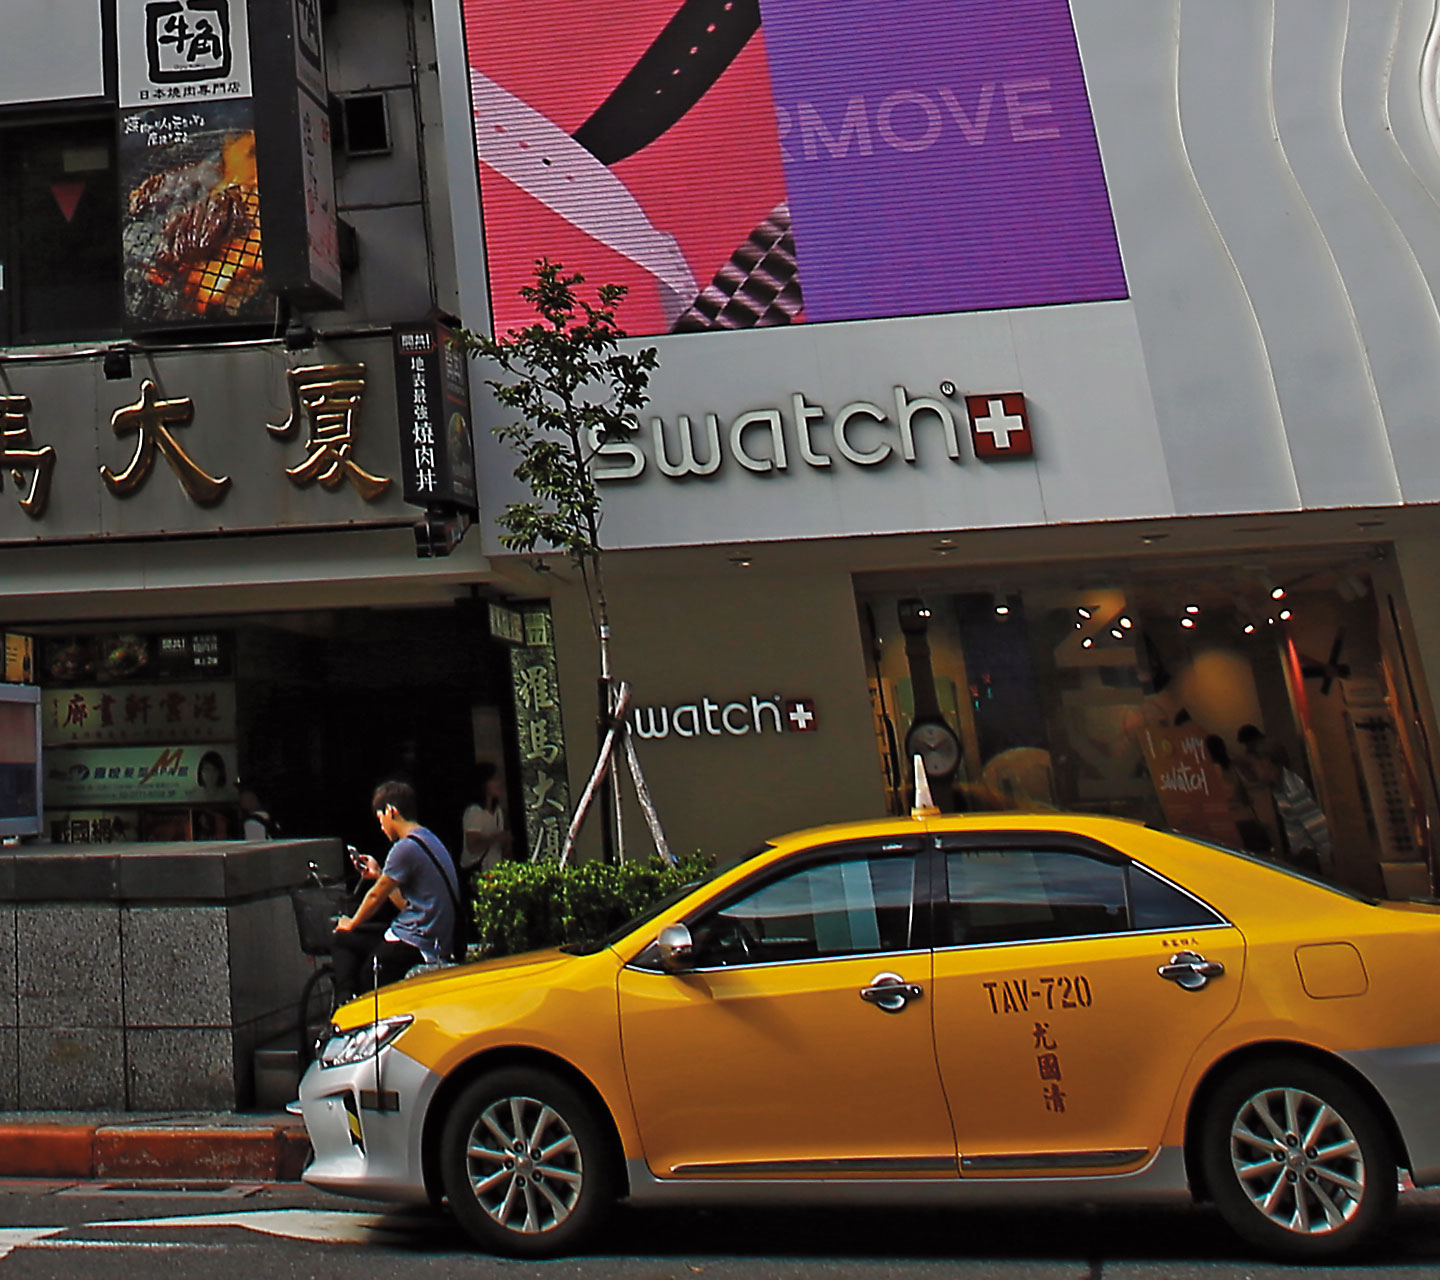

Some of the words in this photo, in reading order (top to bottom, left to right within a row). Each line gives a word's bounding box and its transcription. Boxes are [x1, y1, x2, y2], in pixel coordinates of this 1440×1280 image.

[620, 697, 782, 742] watch
[982, 974, 1093, 1016] TAV-720
[1031, 1021, 1068, 1115] 尤國清
